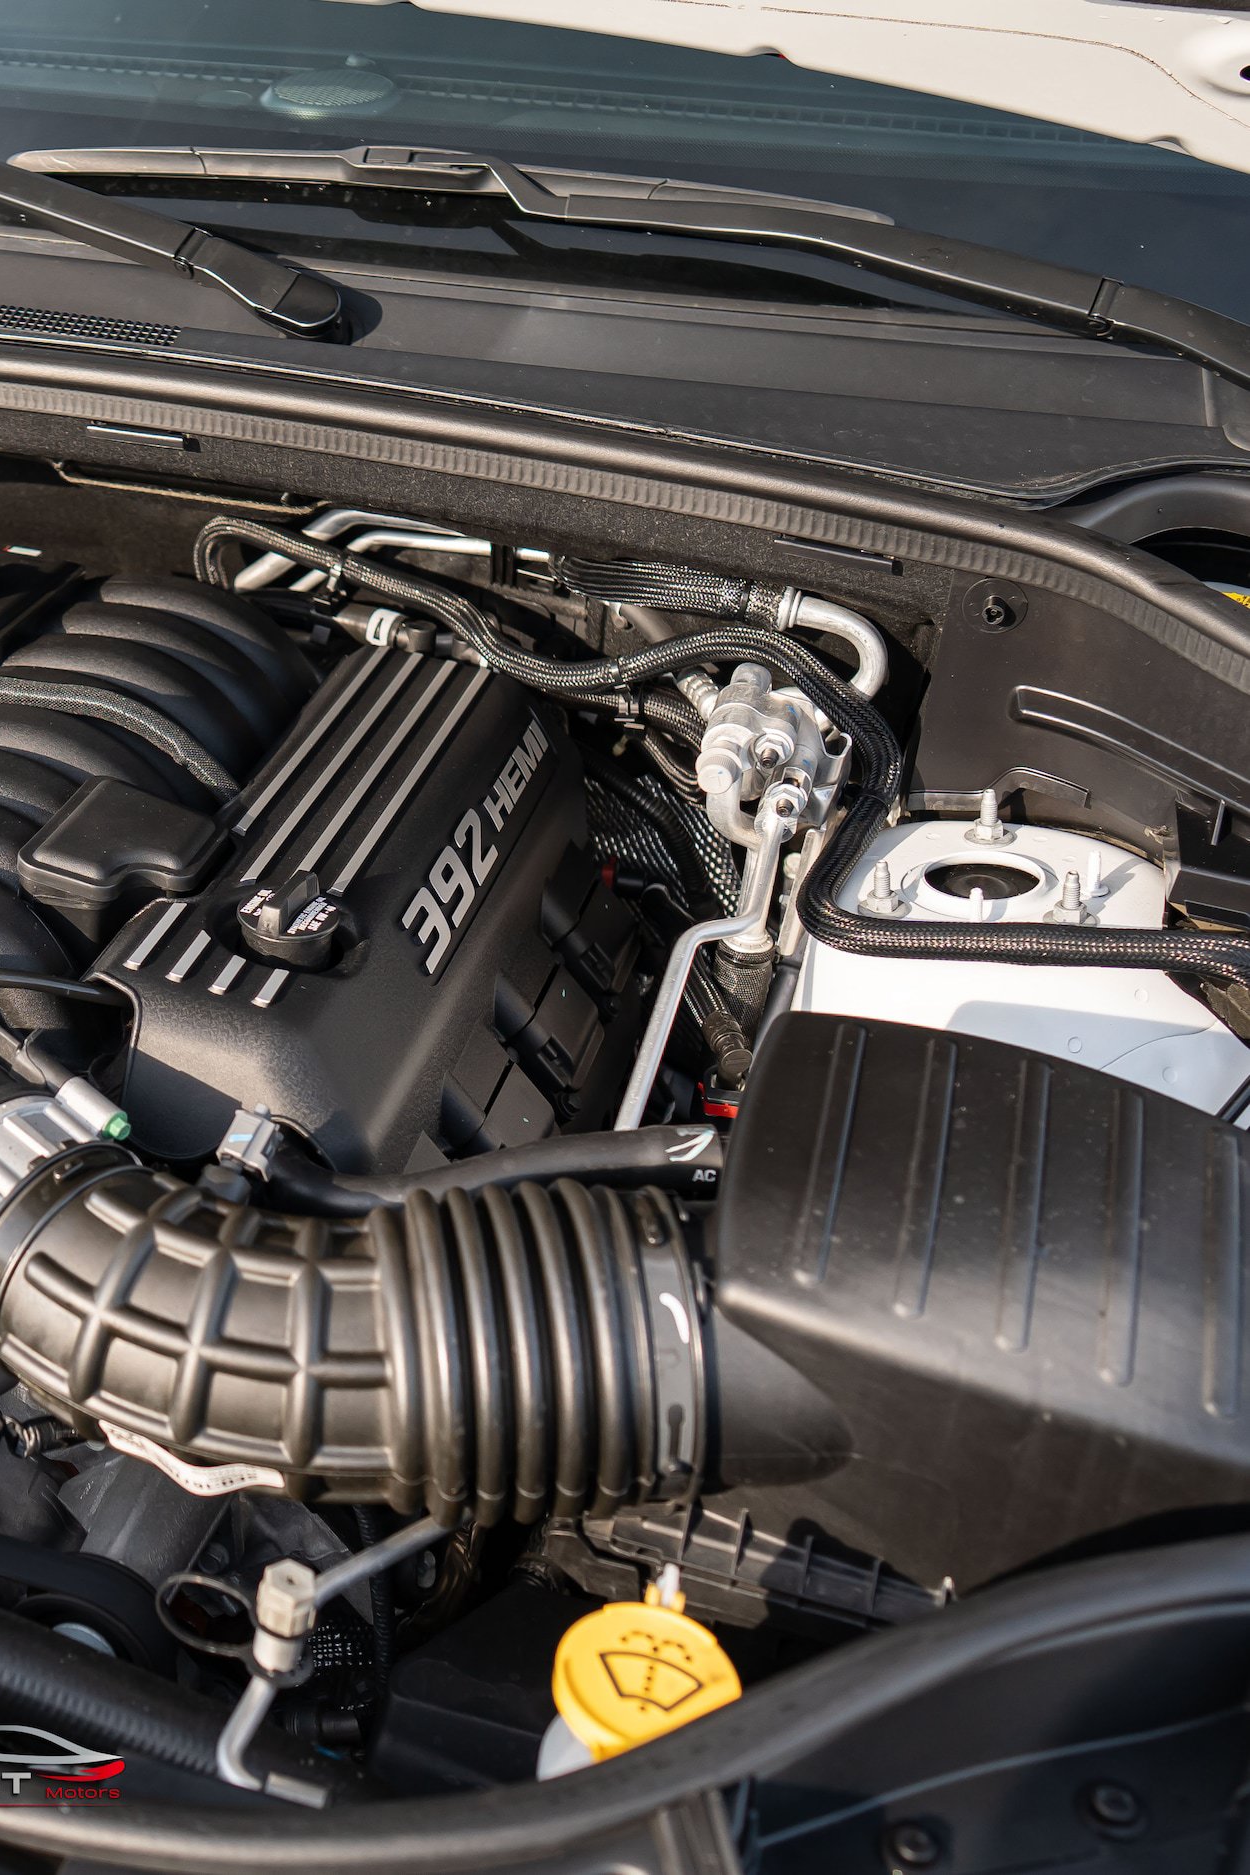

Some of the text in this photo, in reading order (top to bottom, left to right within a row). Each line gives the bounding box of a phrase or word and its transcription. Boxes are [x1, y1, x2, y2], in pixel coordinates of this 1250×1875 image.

[401, 718, 549, 975] 392 HEMI
[692, 1168, 717, 1182] AC
